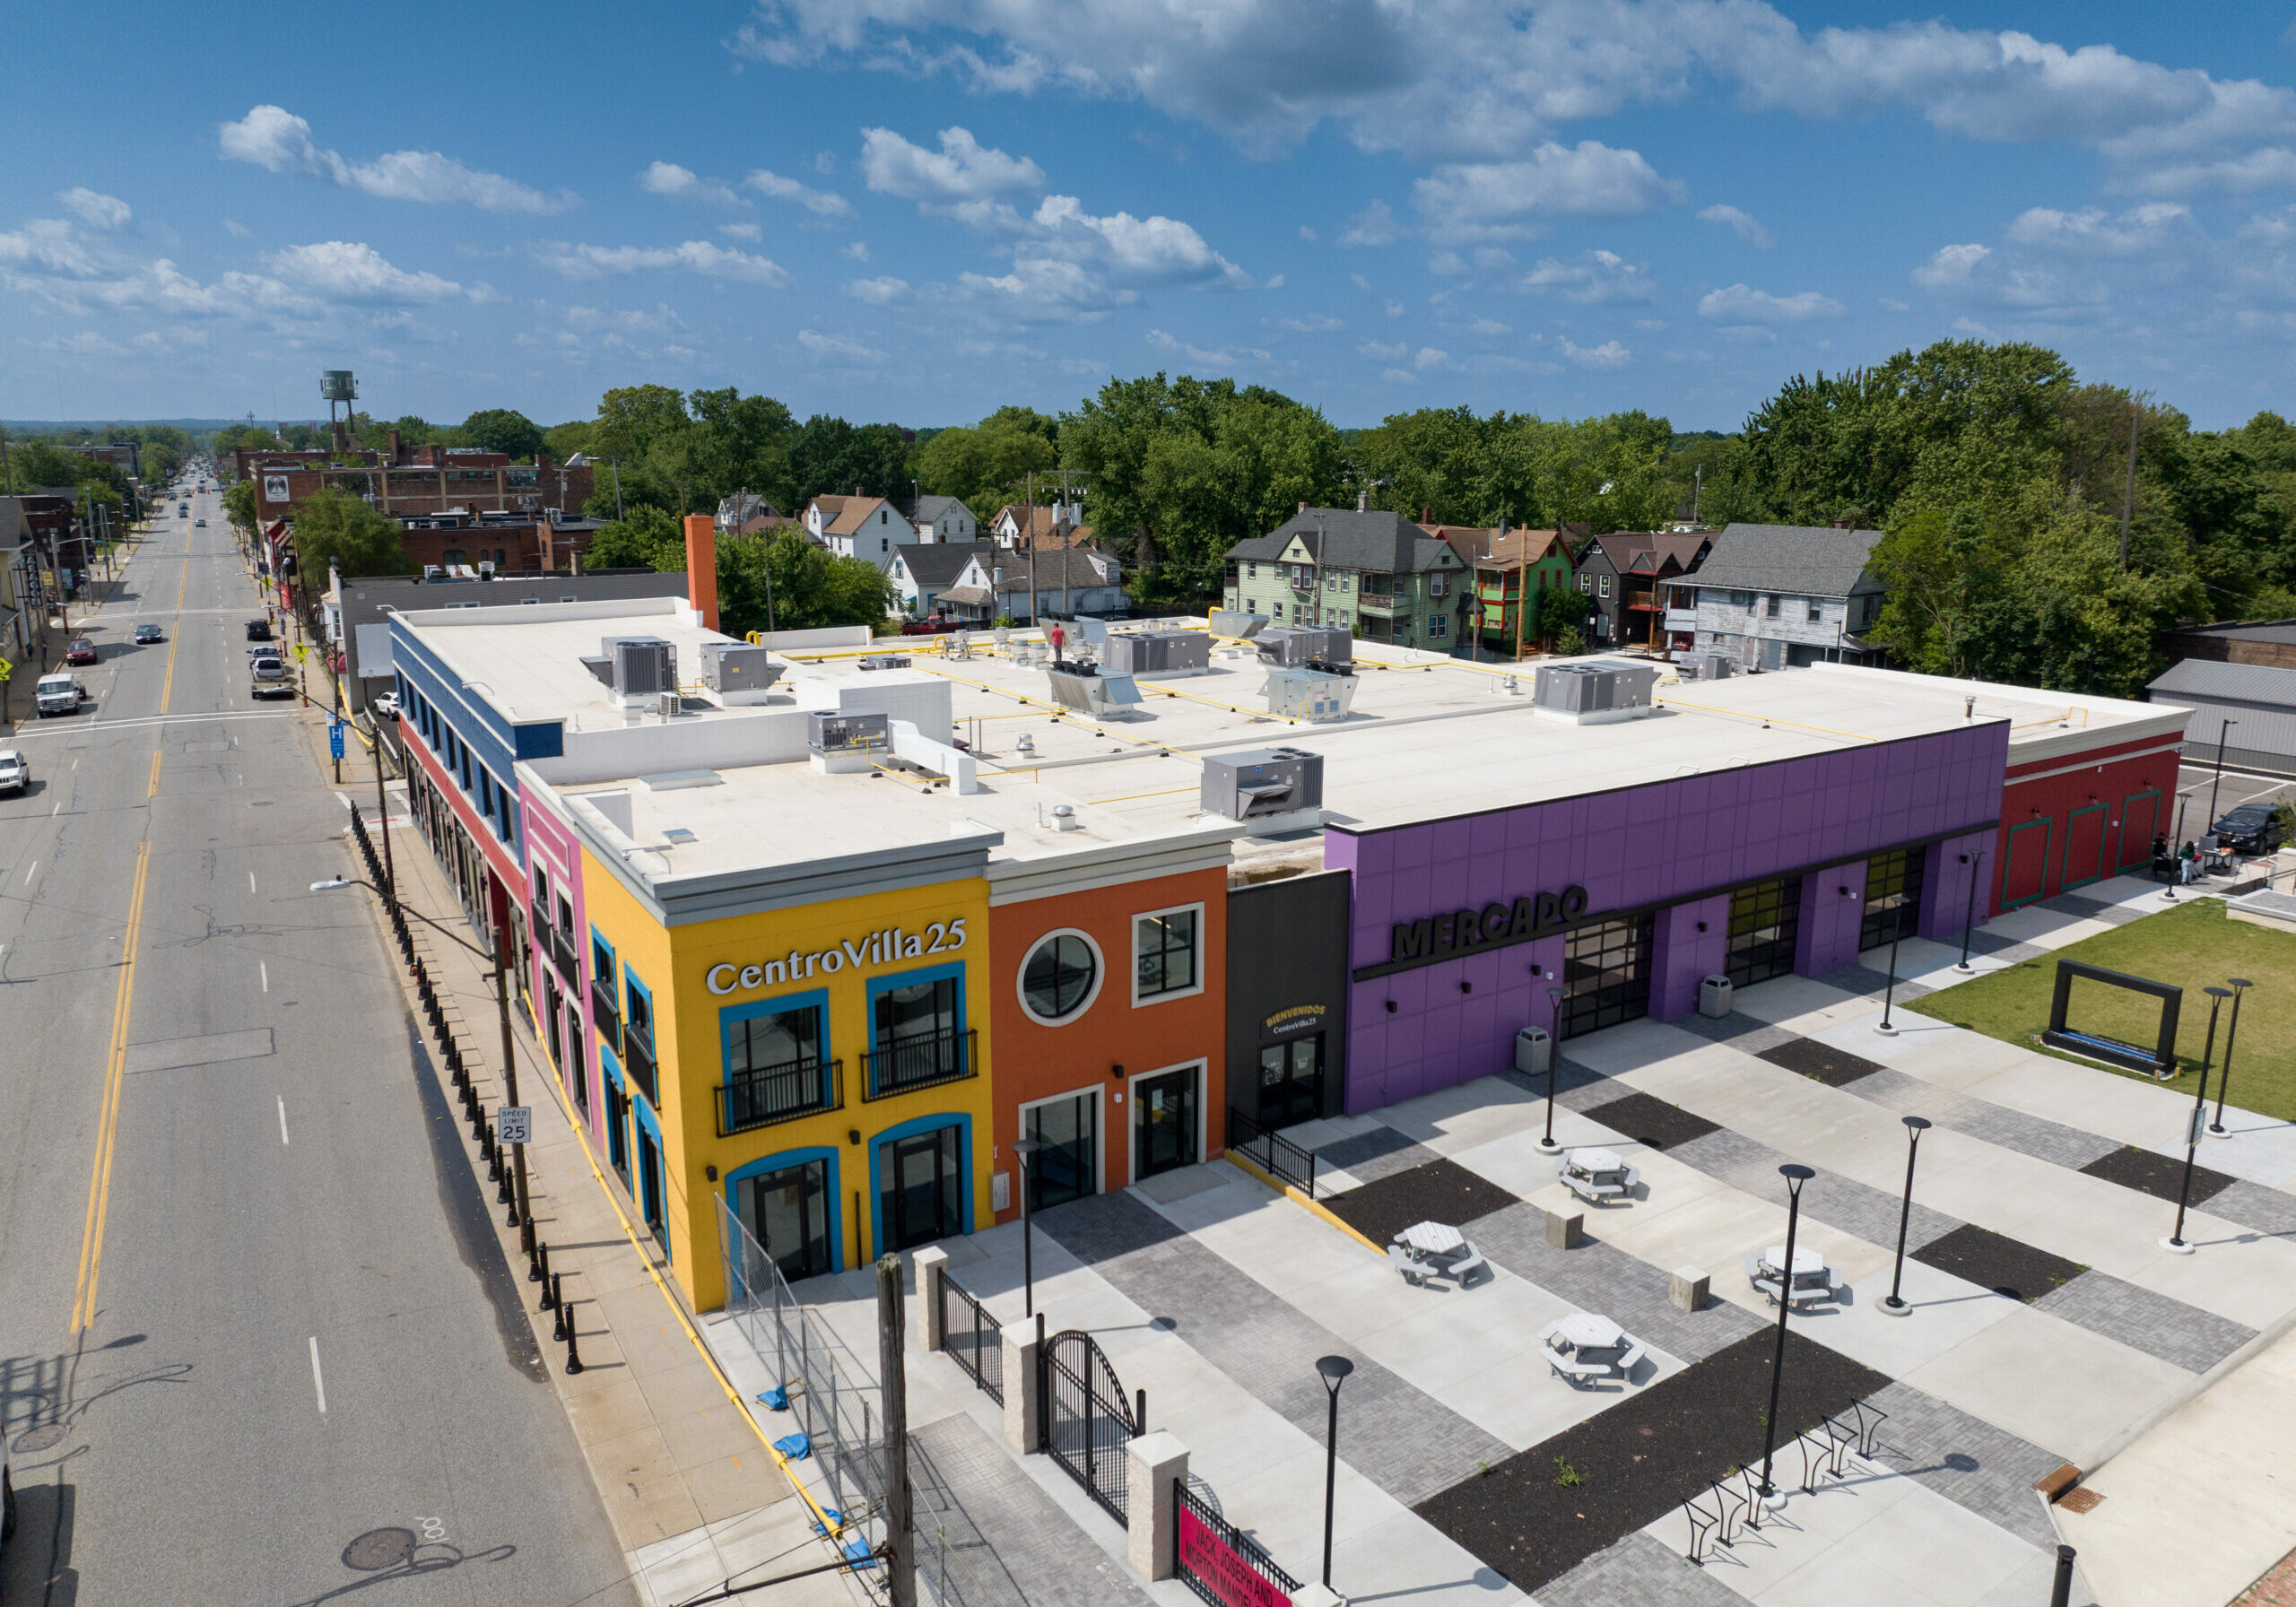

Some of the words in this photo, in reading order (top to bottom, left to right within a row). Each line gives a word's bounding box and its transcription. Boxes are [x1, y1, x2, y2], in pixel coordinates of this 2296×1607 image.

[332, 727, 342, 739] H
[1392, 885, 1588, 961] MERCADO
[1265, 1004, 1326, 1028] BIENVENIDOS
[503, 1125, 525, 1139] 25
[1185, 1539, 1218, 1585] MORTON
[1220, 1550, 1253, 1594] JOSEPH
[1254, 1578, 1273, 1607] AND
